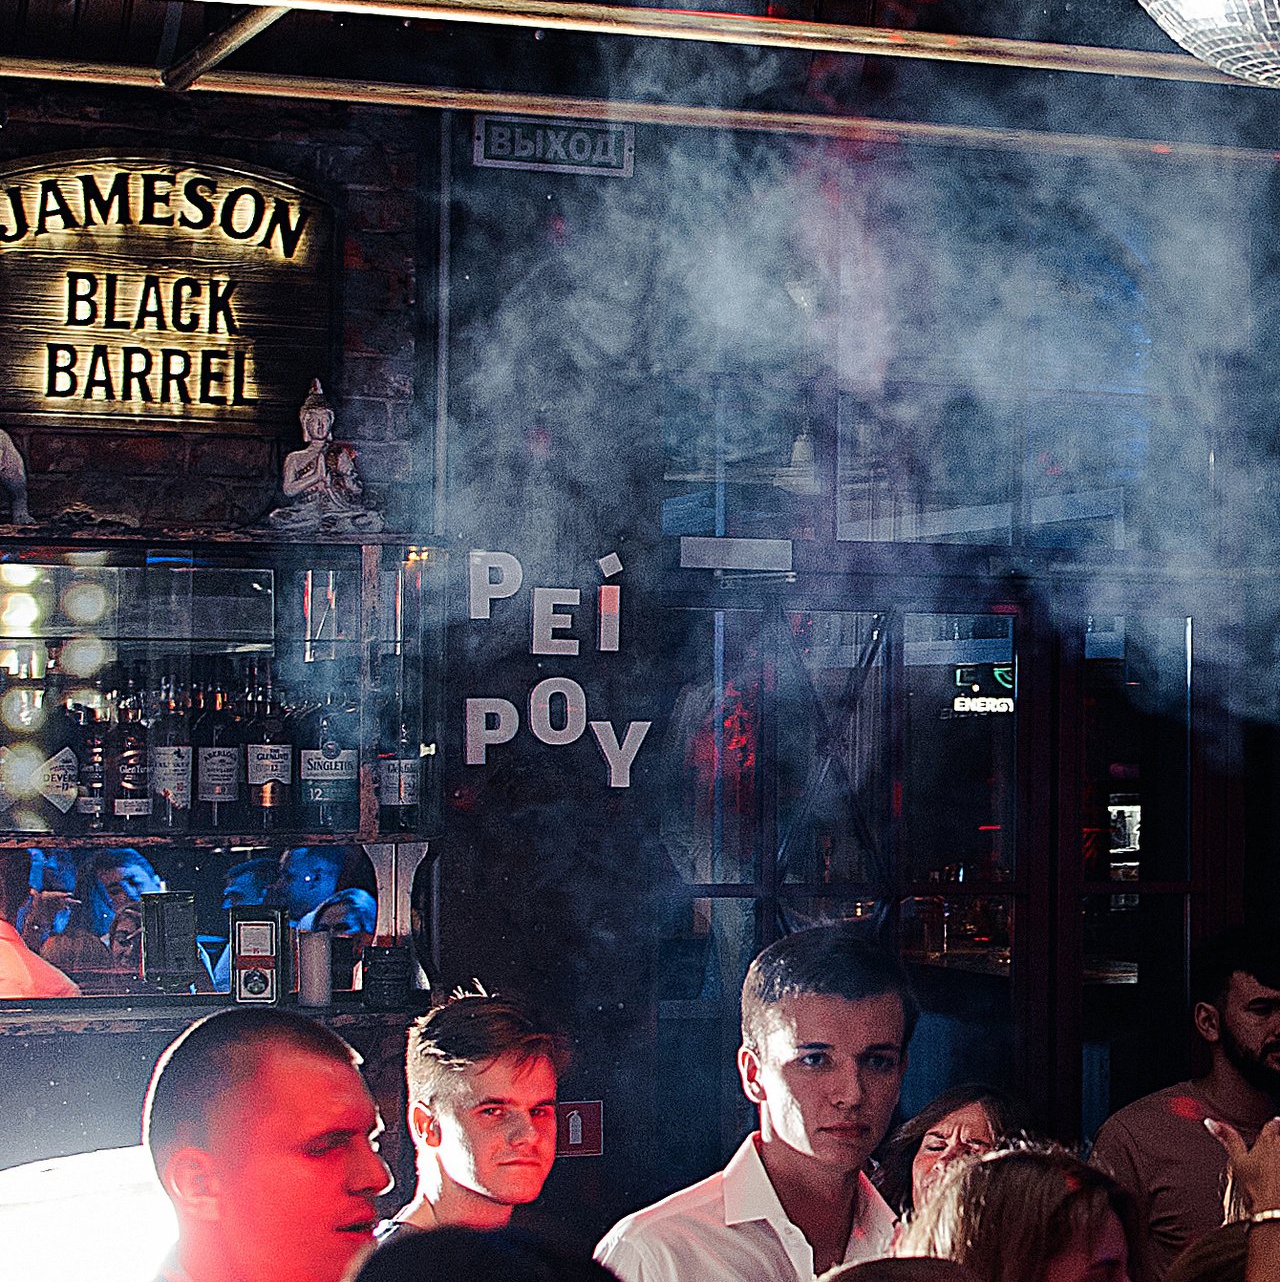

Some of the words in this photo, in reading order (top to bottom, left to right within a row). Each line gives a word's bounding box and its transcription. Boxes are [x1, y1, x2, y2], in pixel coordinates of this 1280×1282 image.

[489, 126, 617, 166] ВЫХОД
[0, 173, 311, 258] JAMESON
[65, 271, 240, 335] BLACK
[46, 343, 259, 406] BARREL
[465, 677, 652, 788] POY
[309, 788, 323, 800] 12
